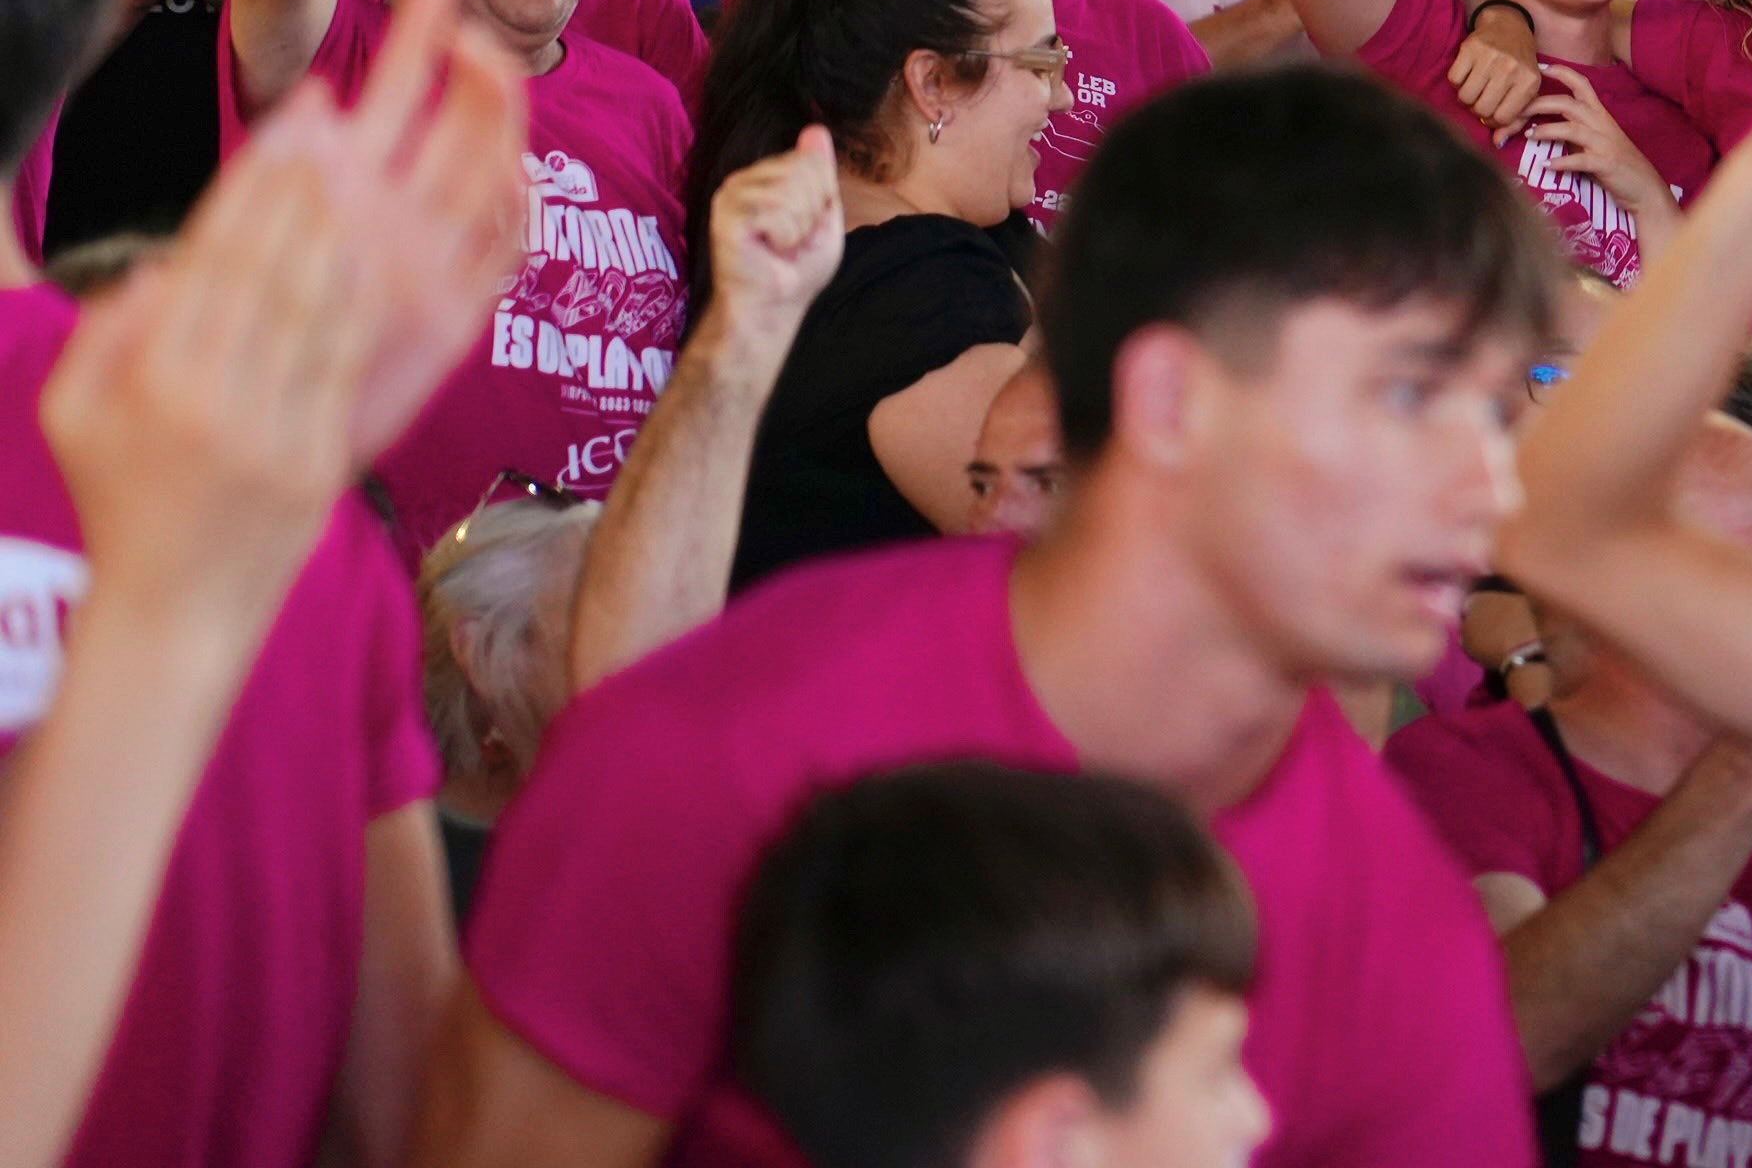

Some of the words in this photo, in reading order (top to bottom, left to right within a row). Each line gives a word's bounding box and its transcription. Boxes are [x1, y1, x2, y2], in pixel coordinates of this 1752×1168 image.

[1078, 73, 1116, 95] LEB
[1078, 89, 1106, 108] OR
[491, 298, 534, 369] ÉS
[1578, 1084, 1610, 1149] S
